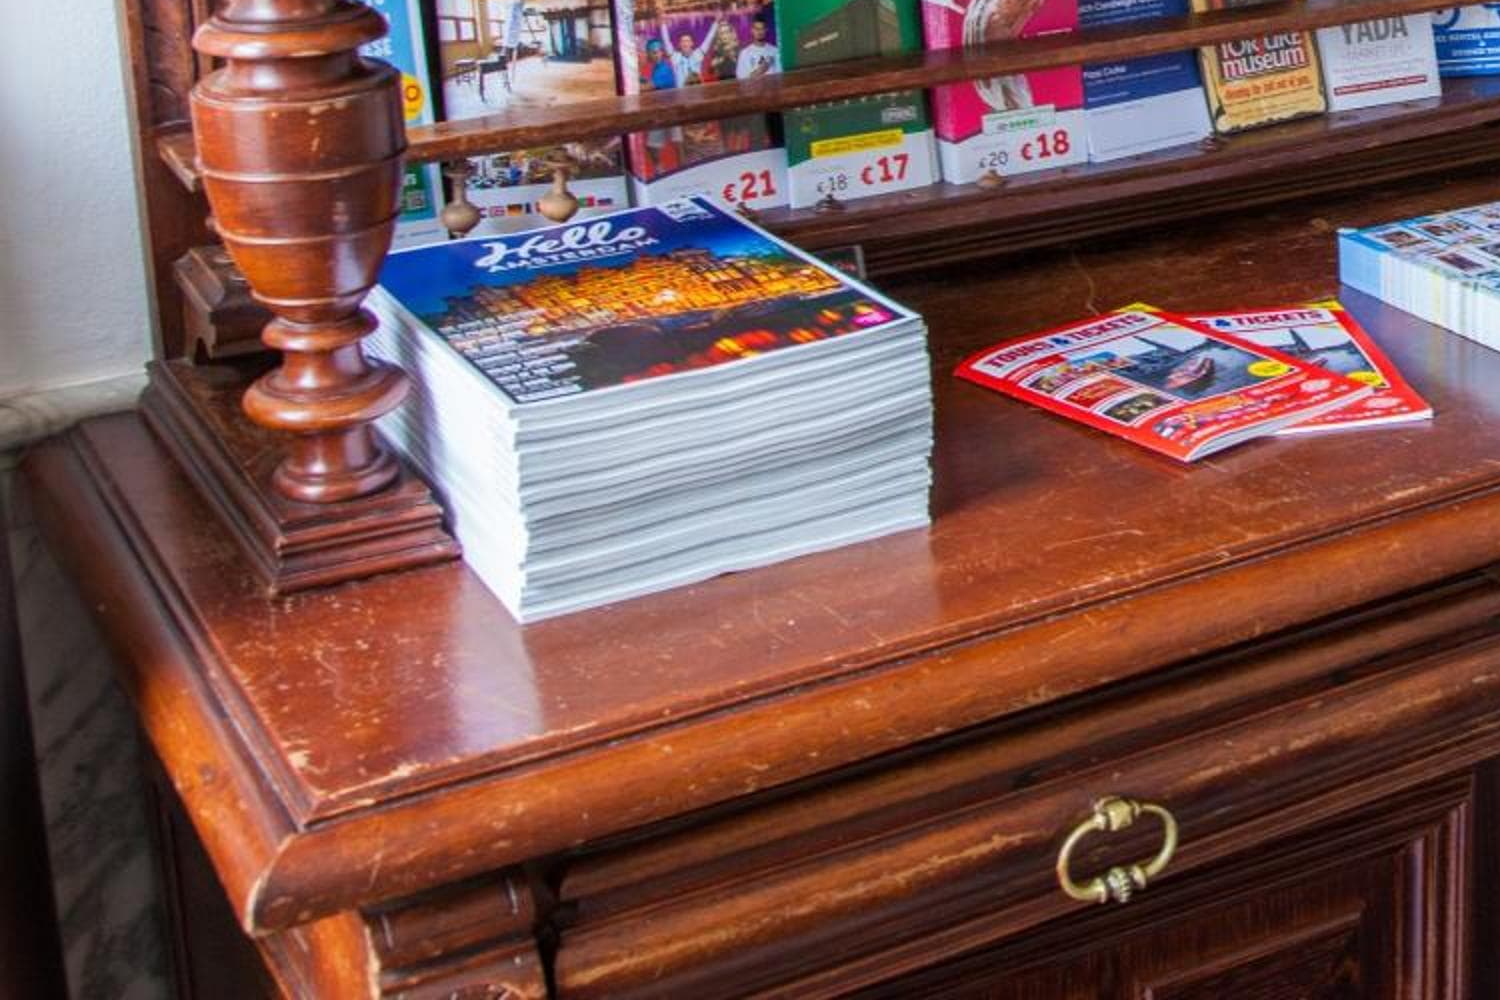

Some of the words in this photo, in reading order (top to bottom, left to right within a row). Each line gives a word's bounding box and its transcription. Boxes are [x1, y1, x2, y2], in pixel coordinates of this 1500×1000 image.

[1221, 46, 1307, 81] museum
[474, 221, 648, 269] Hello
[488, 237, 661, 274] AMSTERDAM
[1233, 309, 1324, 328] TICKETS
[984, 340, 1056, 369] TOURS
[1065, 313, 1148, 342] TICKETS
